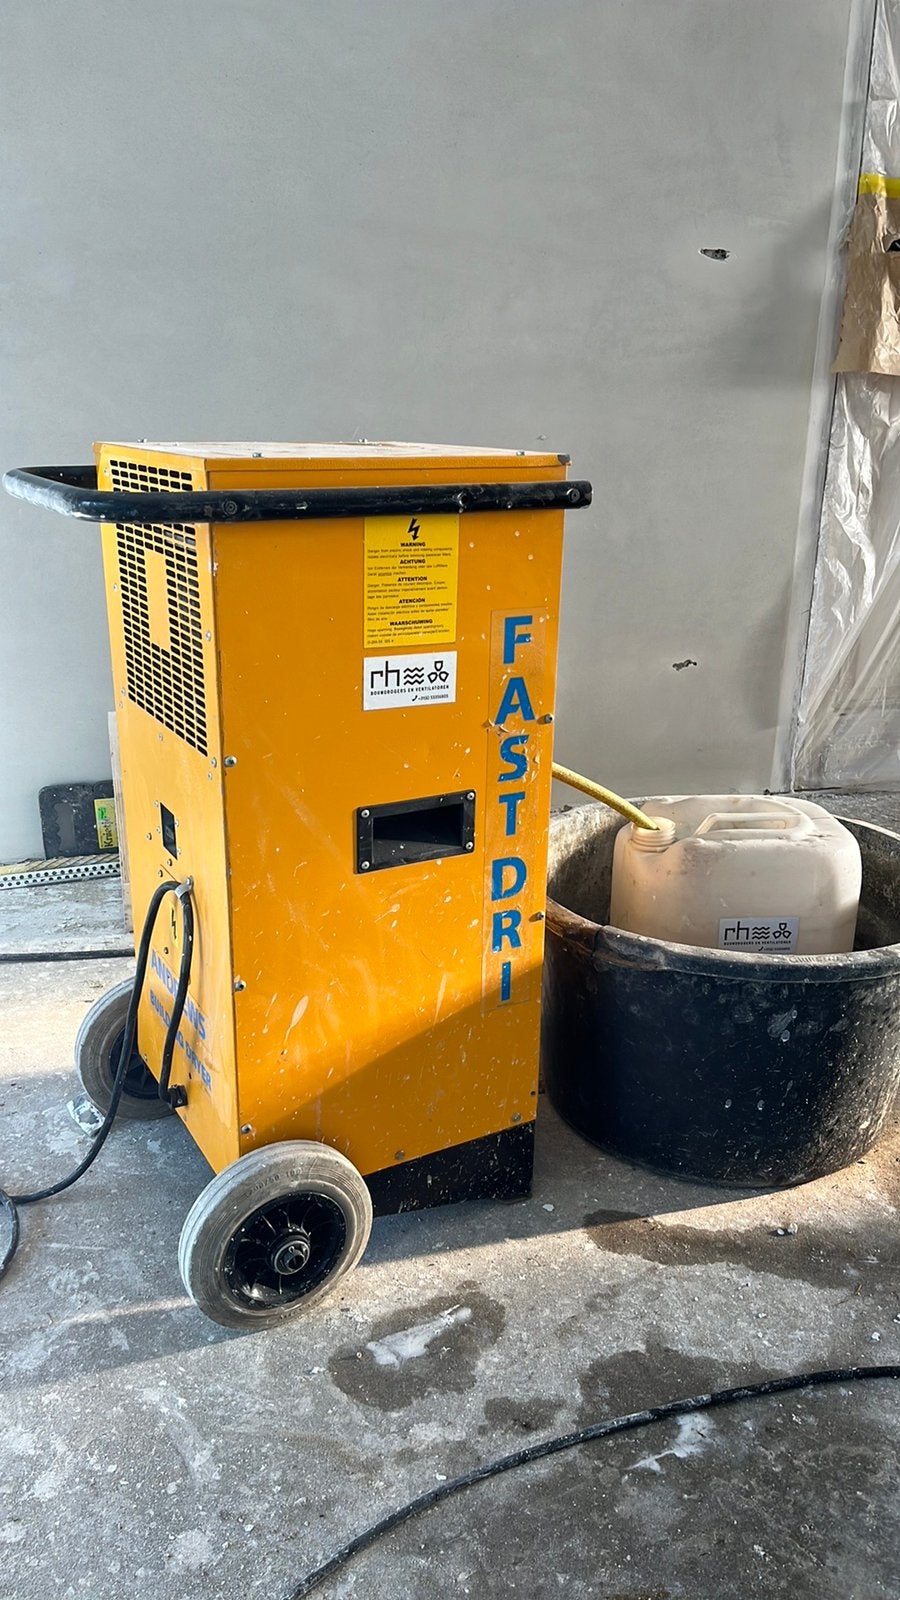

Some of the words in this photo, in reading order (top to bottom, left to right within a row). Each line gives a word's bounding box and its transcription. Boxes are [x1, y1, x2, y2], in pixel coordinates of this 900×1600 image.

[389, 618, 434, 626] WAARSCHUWING
[370, 661, 400, 689] rh
[370, 688, 407, 696] BOUWDROGERS
[415, 684, 450, 692] VENTILATOREN
[494, 615, 535, 836] FAST
[490, 856, 528, 1001] DRI
[724, 921, 749, 941] rh
[150, 989, 184, 1049] BUILDG
